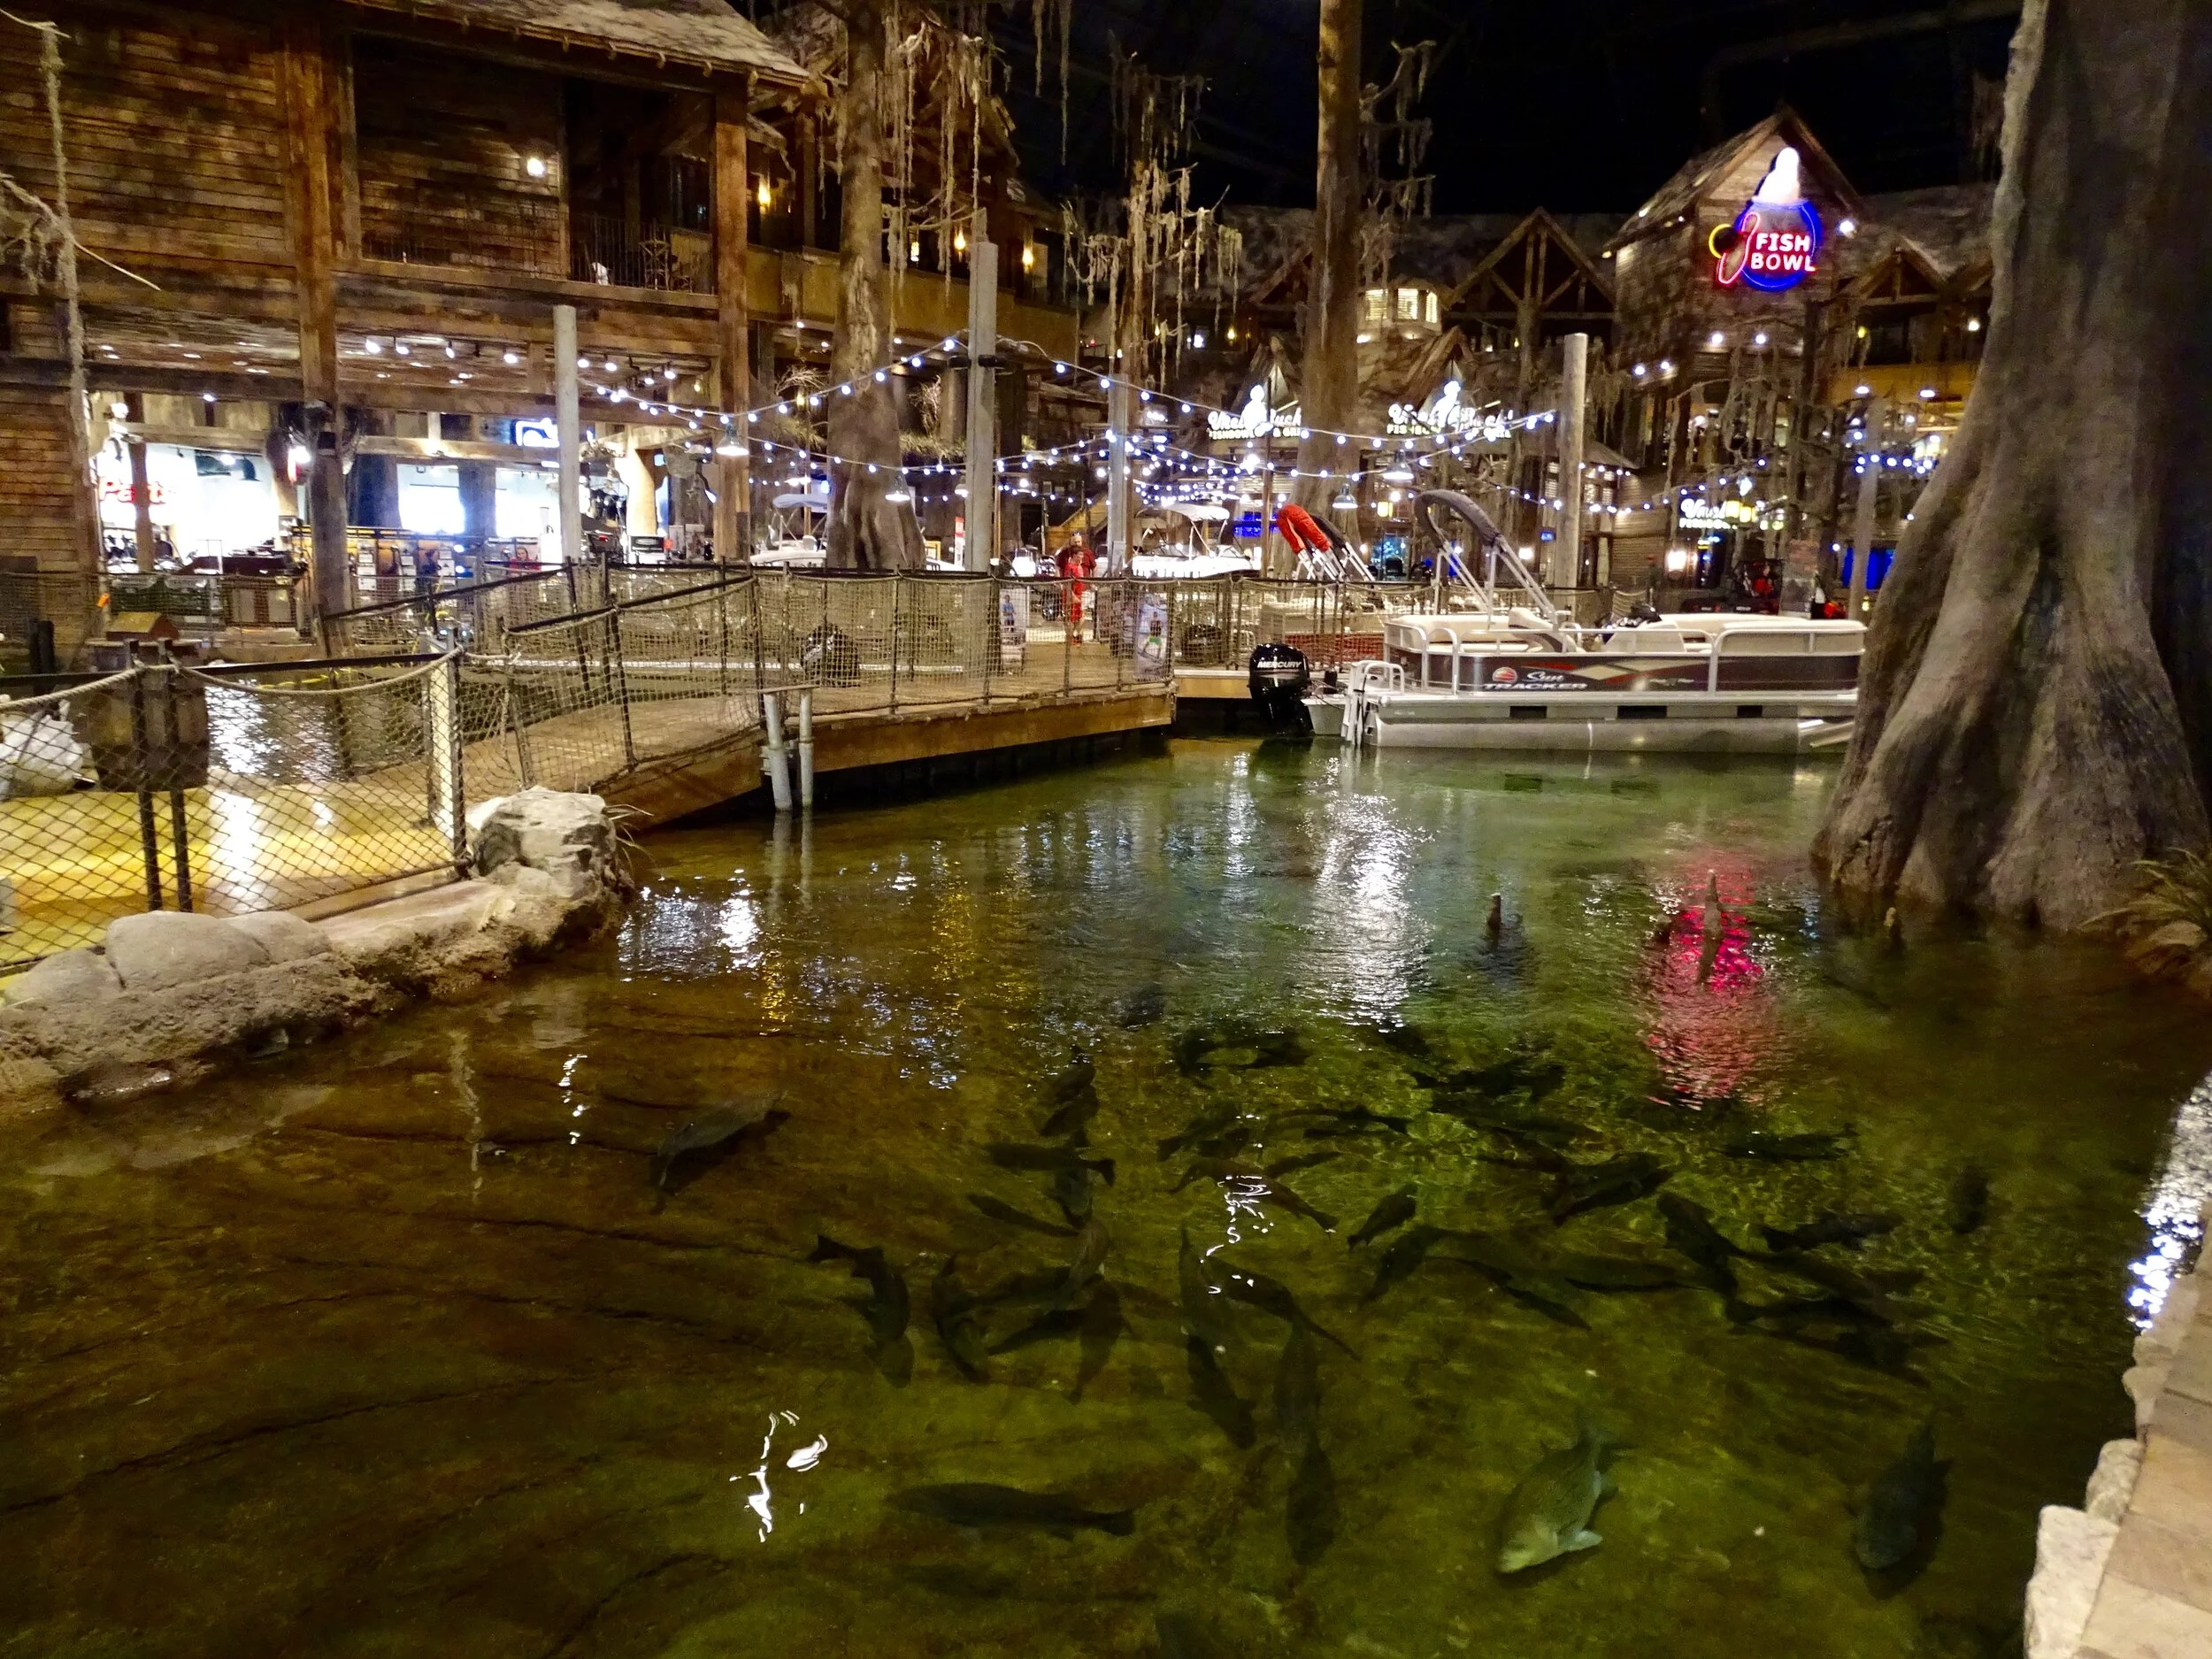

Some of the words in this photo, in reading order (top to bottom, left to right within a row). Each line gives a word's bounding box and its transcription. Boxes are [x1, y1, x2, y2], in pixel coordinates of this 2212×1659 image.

[1755, 233, 1810, 252] FISH
[1751, 252, 1816, 272] BOWL
[99, 476, 178, 506] Pats
[1522, 671, 1564, 682] Sun
